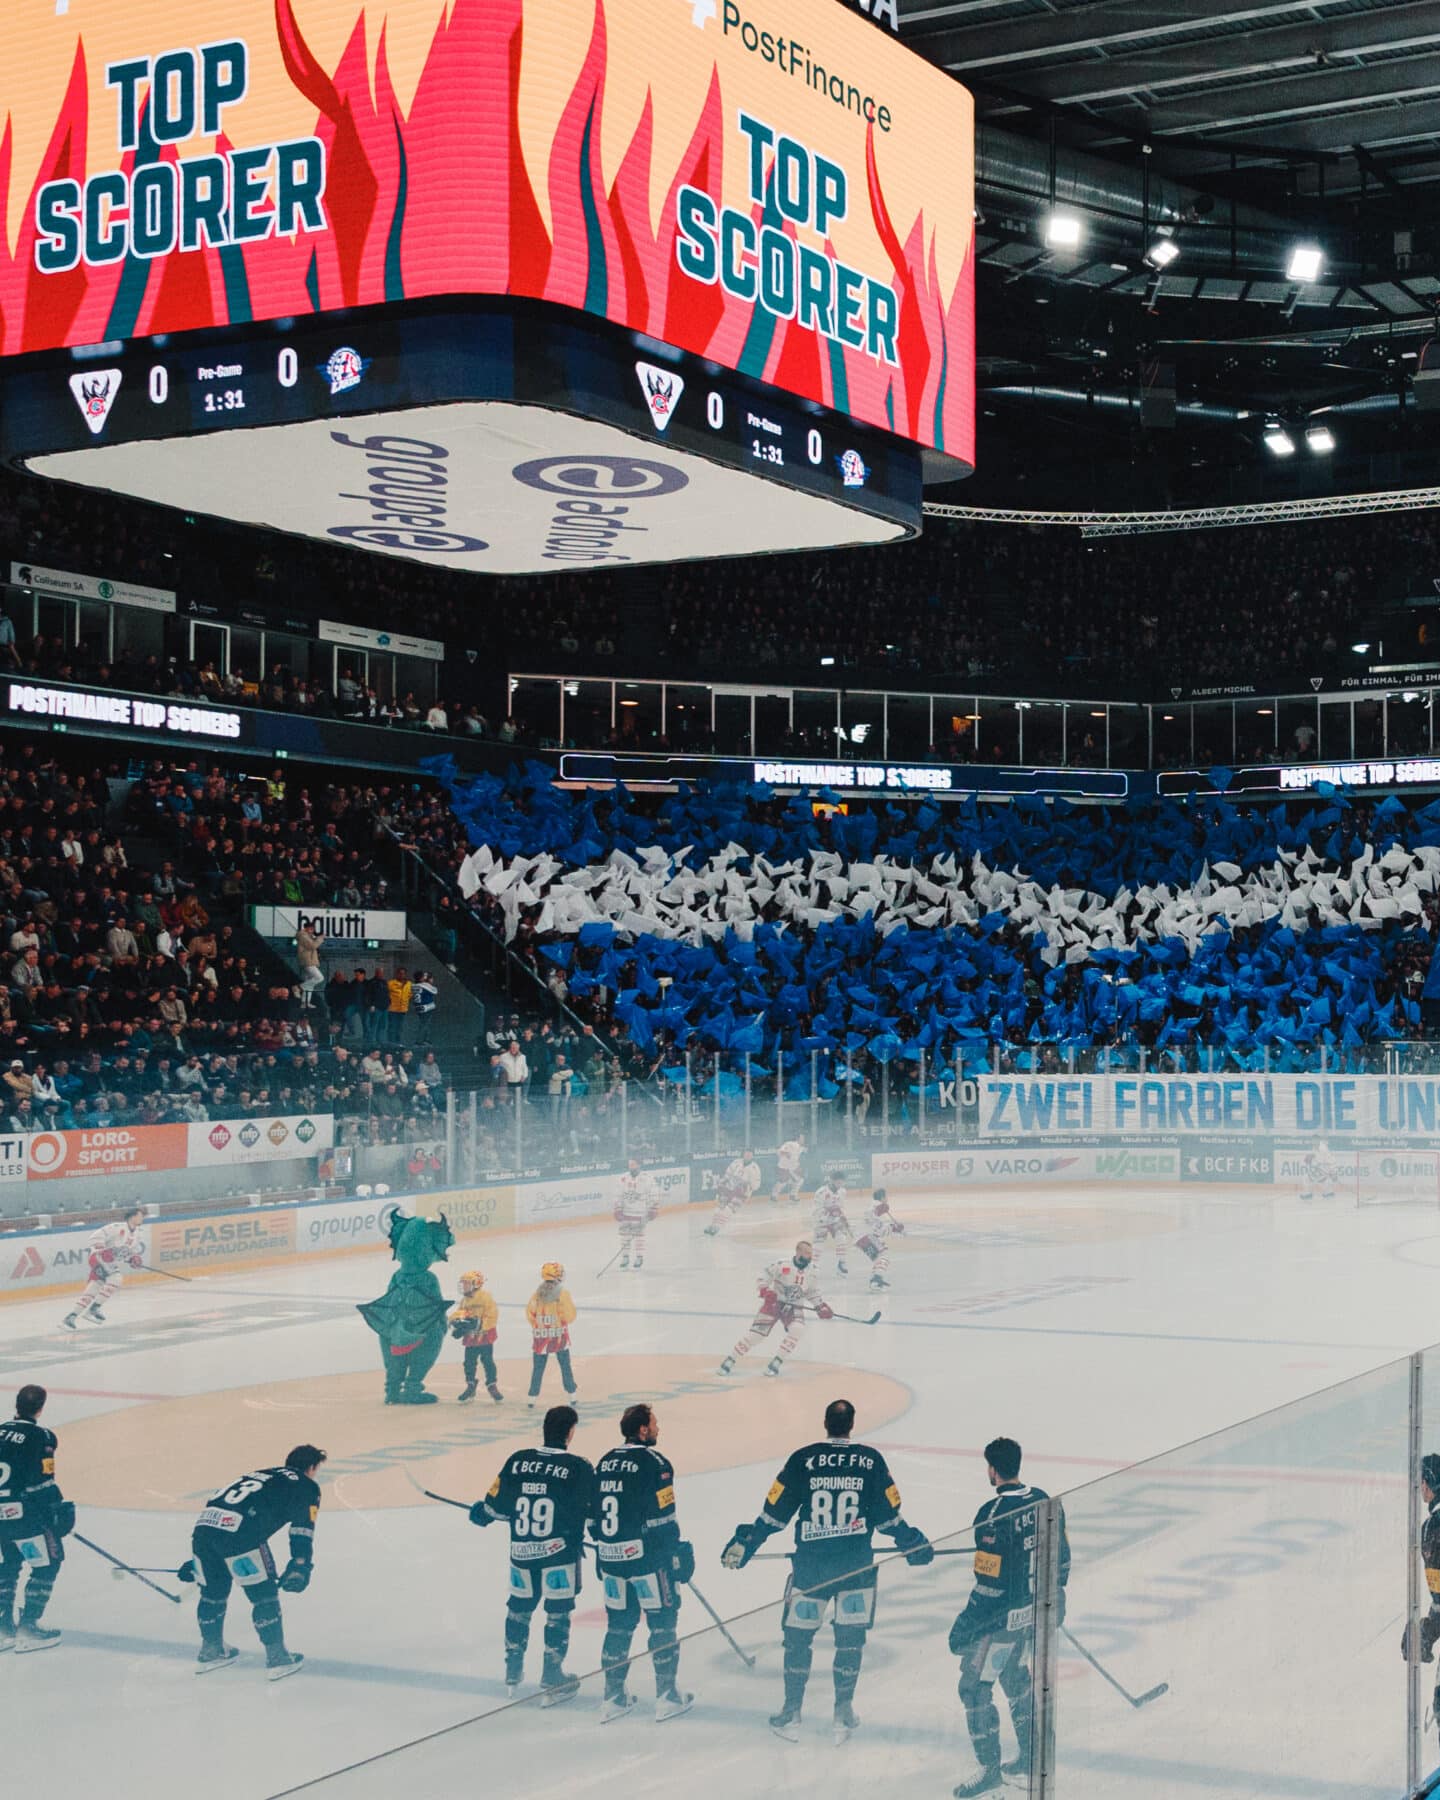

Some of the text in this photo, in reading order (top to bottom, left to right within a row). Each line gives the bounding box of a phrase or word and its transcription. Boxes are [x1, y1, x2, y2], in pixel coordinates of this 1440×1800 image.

[721, 0, 892, 133] PostFinance
[105, 38, 248, 153] TOP
[738, 108, 848, 238] TOP
[35, 137, 326, 274] SCORER
[676, 184, 901, 368] SCORER
[278, 347, 297, 388] 0
[150, 365, 168, 404] 0
[204, 390, 245, 412] 1:31
[707, 392, 724, 430] 0
[752, 440, 784, 466] 1:31
[807, 429, 822, 464] 0
[34, 575, 84, 591] Coliseum SA
[1191, 684, 1256, 696] ALBERT MICHEL
[132, 700, 165, 727] TOP
[856, 766, 885, 787] TOP
[1369, 764, 1394, 784] TOP
[987, 1081, 1092, 1131] ZWEI
[1115, 1080, 1274, 1130] FARBEN
[1295, 1080, 1356, 1130] DIE
[81, 1131, 136, 1147] LORO-
[78, 1147, 139, 1165] SPORT
[881, 1159, 950, 1176] SPONSER
[985, 1159, 1042, 1174] VARO
[1095, 1150, 1176, 1177] WAGO
[436, 1199, 497, 1216] CHICCO
[184, 1219, 268, 1247] FASEL
[310, 1209, 375, 1241] groupe
[522, 1482, 547, 1495] REBER
[810, 1477, 864, 1491] SPRUNGER
[515, 1497, 555, 1536] 39
[601, 1496, 619, 1536] 3
[811, 1490, 859, 1528] 86
